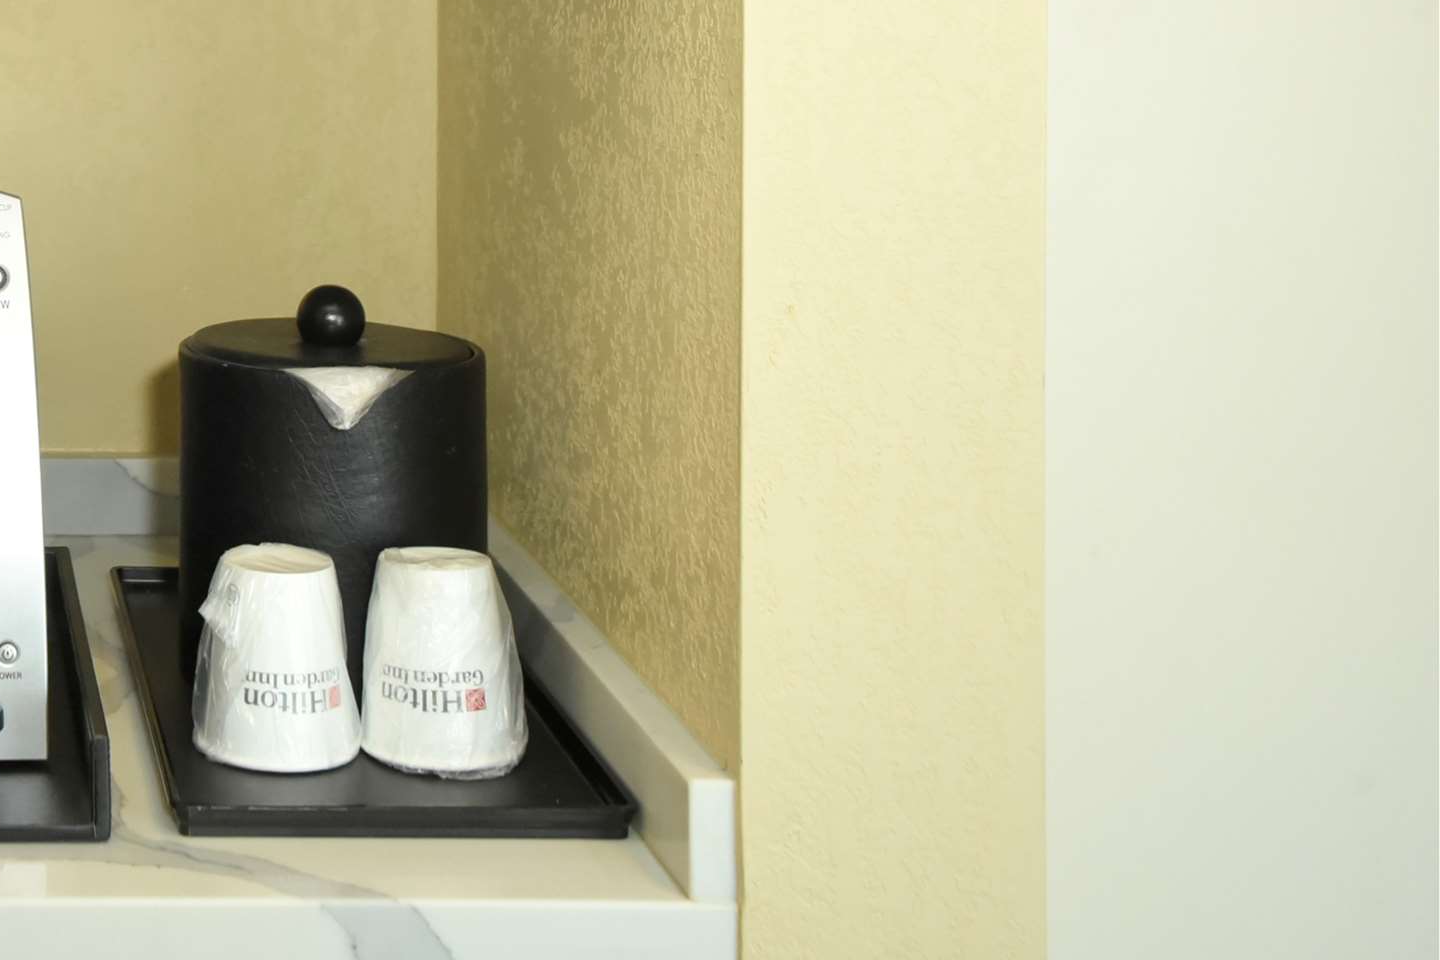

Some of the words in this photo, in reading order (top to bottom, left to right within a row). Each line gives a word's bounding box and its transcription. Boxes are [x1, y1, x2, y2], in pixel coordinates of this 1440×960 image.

[245, 670, 279, 688] Inn
[413, 669, 485, 687] Garden
[243, 688, 327, 714] Hilton
[381, 681, 464, 713] Hilton
